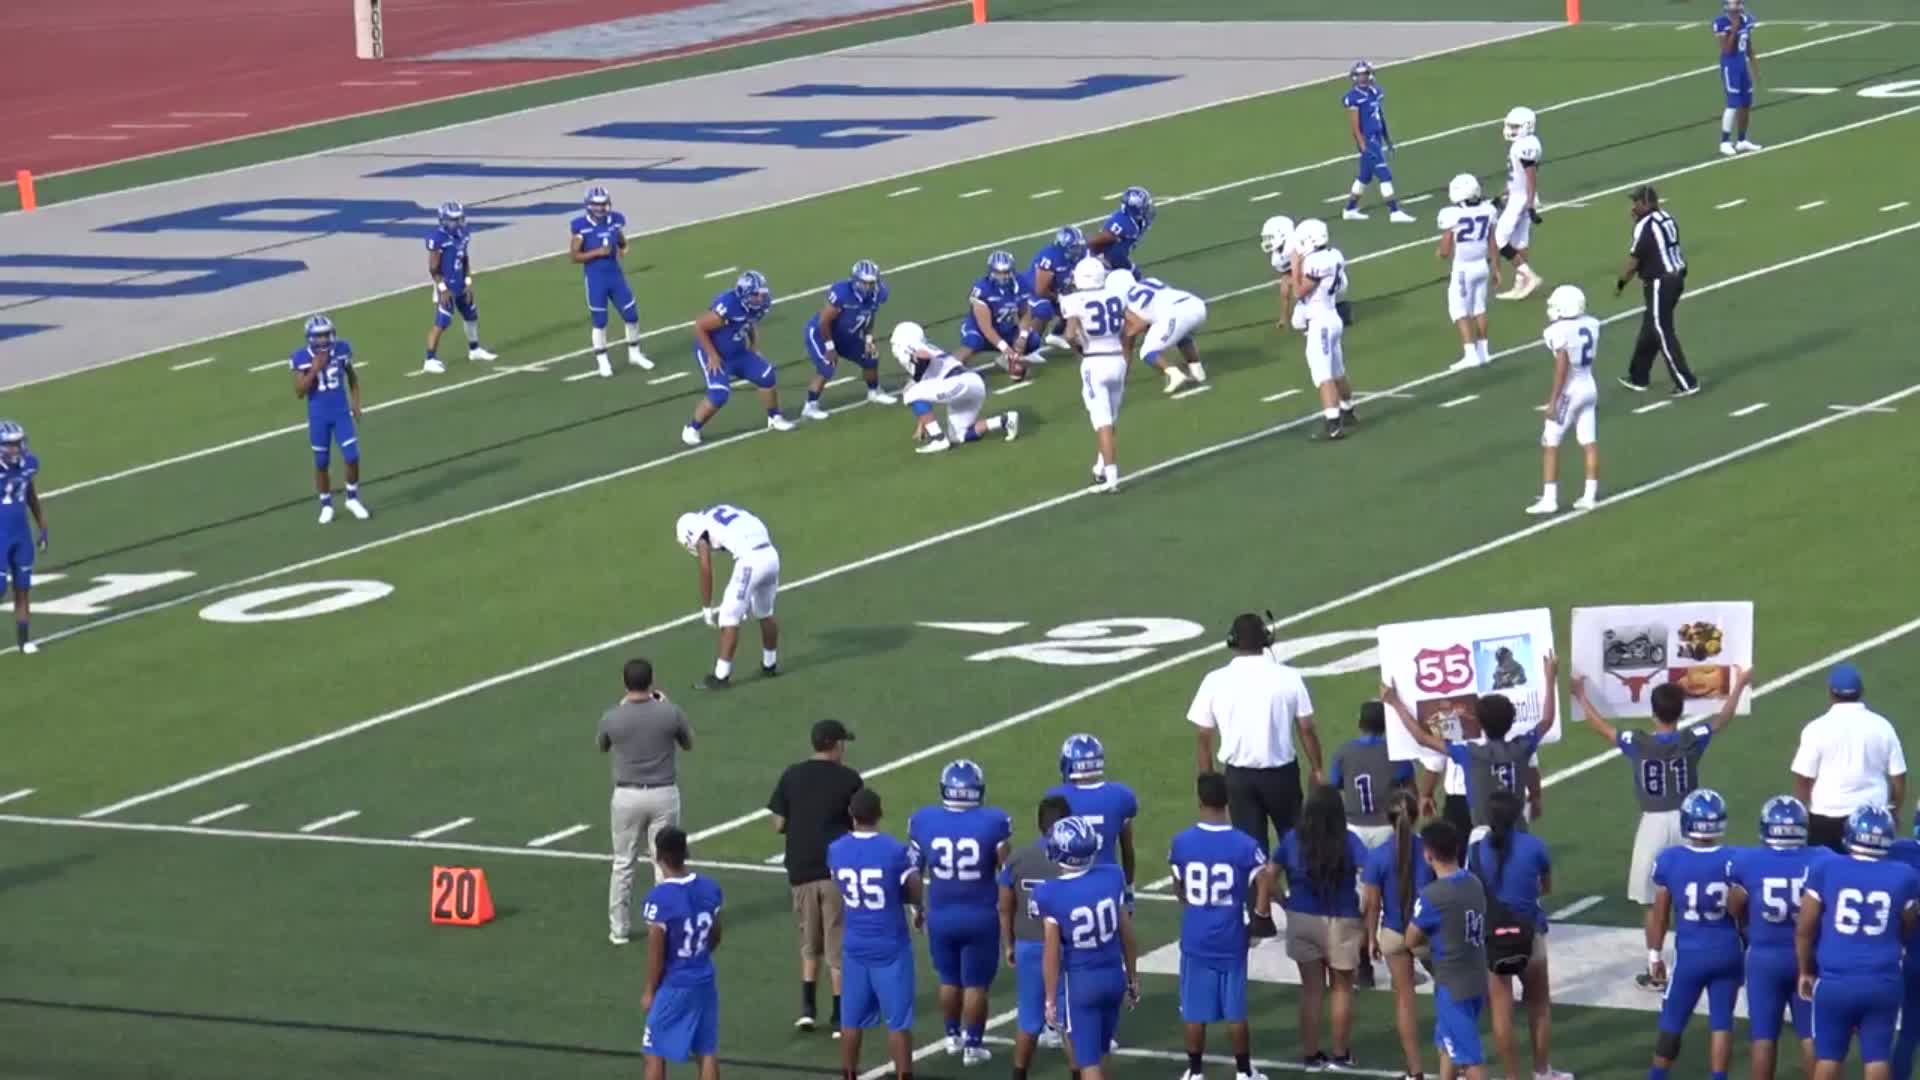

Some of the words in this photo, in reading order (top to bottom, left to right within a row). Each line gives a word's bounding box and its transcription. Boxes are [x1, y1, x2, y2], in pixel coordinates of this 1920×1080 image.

[1456, 216, 1489, 242] 27
[1085, 296, 1124, 337] 38
[1578, 327, 1593, 366] 2
[317, 366, 339, 392] 15
[1418, 653, 1470, 688] 55
[1355, 774, 1374, 813] 1
[931, 837, 982, 881] 32
[435, 870, 476, 920] 20
[838, 868, 885, 910] 35
[1186, 862, 1234, 906] 82
[1683, 881, 1729, 921] 13
[1070, 897, 1118, 948] 20
[1834, 888, 1881, 936] 63
[677, 911, 712, 958] 12
